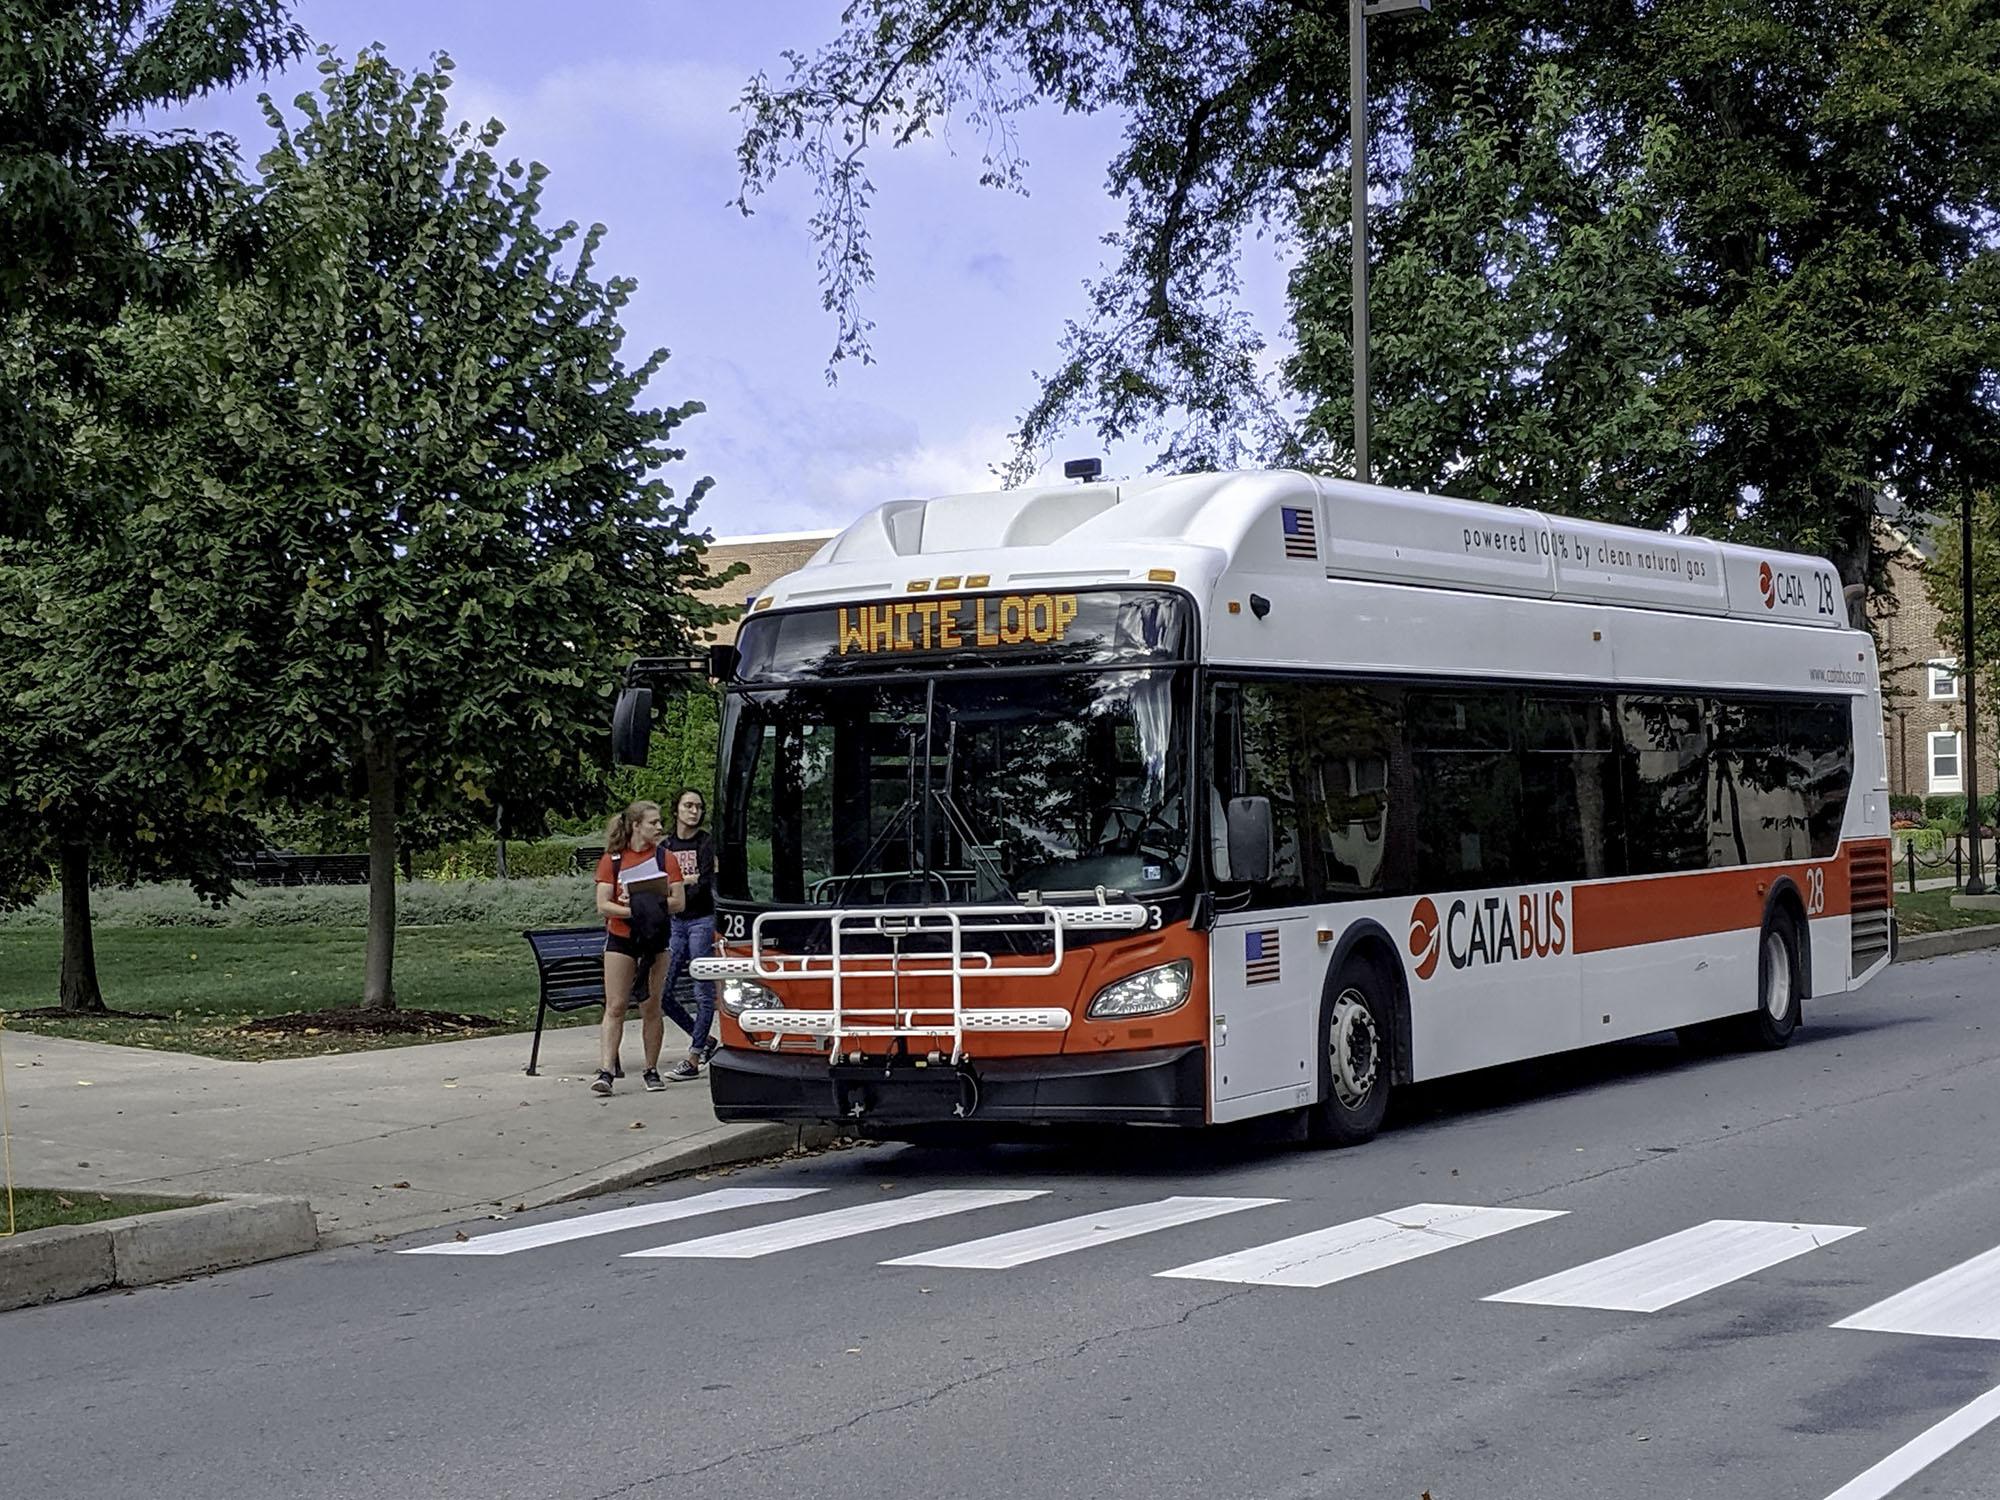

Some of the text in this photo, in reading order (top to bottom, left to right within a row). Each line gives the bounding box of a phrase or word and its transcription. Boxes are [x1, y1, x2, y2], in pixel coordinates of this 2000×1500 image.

[1463, 528, 1706, 580] powered 100% by clean natural gas
[1777, 573, 1806, 607] CATA
[1815, 571, 1834, 615] 28
[839, 594, 1077, 656] WHITE LOOP
[1806, 867, 1824, 915] 28
[724, 914, 745, 938] 28
